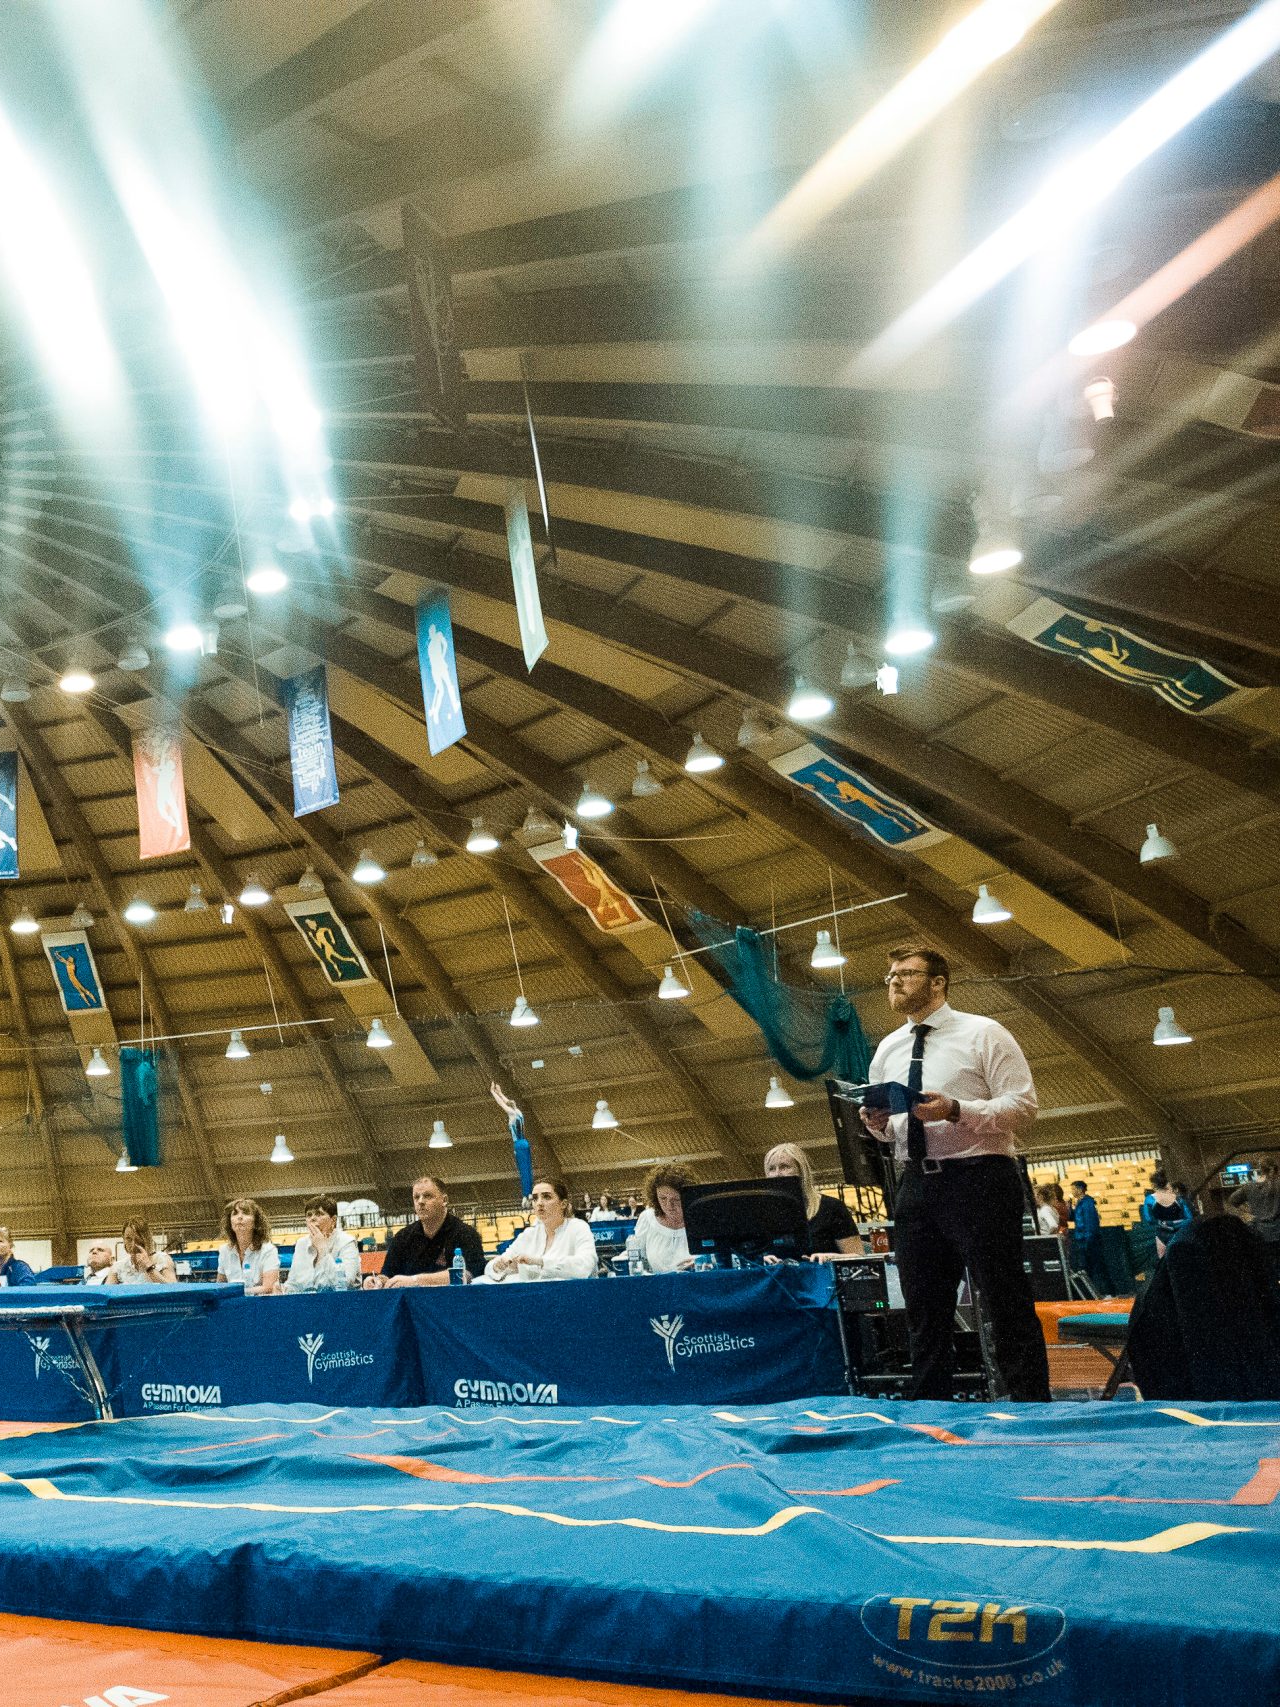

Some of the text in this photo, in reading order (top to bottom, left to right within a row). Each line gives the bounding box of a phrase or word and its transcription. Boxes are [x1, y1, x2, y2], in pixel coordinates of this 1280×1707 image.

[675, 1336, 756, 1358] Gymnastics
[683, 1331, 730, 1346] Scottish
[314, 1353, 374, 1371] Gymnastics
[320, 1349, 356, 1361] Scottish
[141, 1383, 222, 1404] GYMNOVA
[453, 1379, 559, 1404] GYMNOVA
[173, 1403, 184, 1411] For
[889, 1597, 1031, 1644] T2K
[872, 1654, 1067, 1691] www.tracks2000.co.uk
